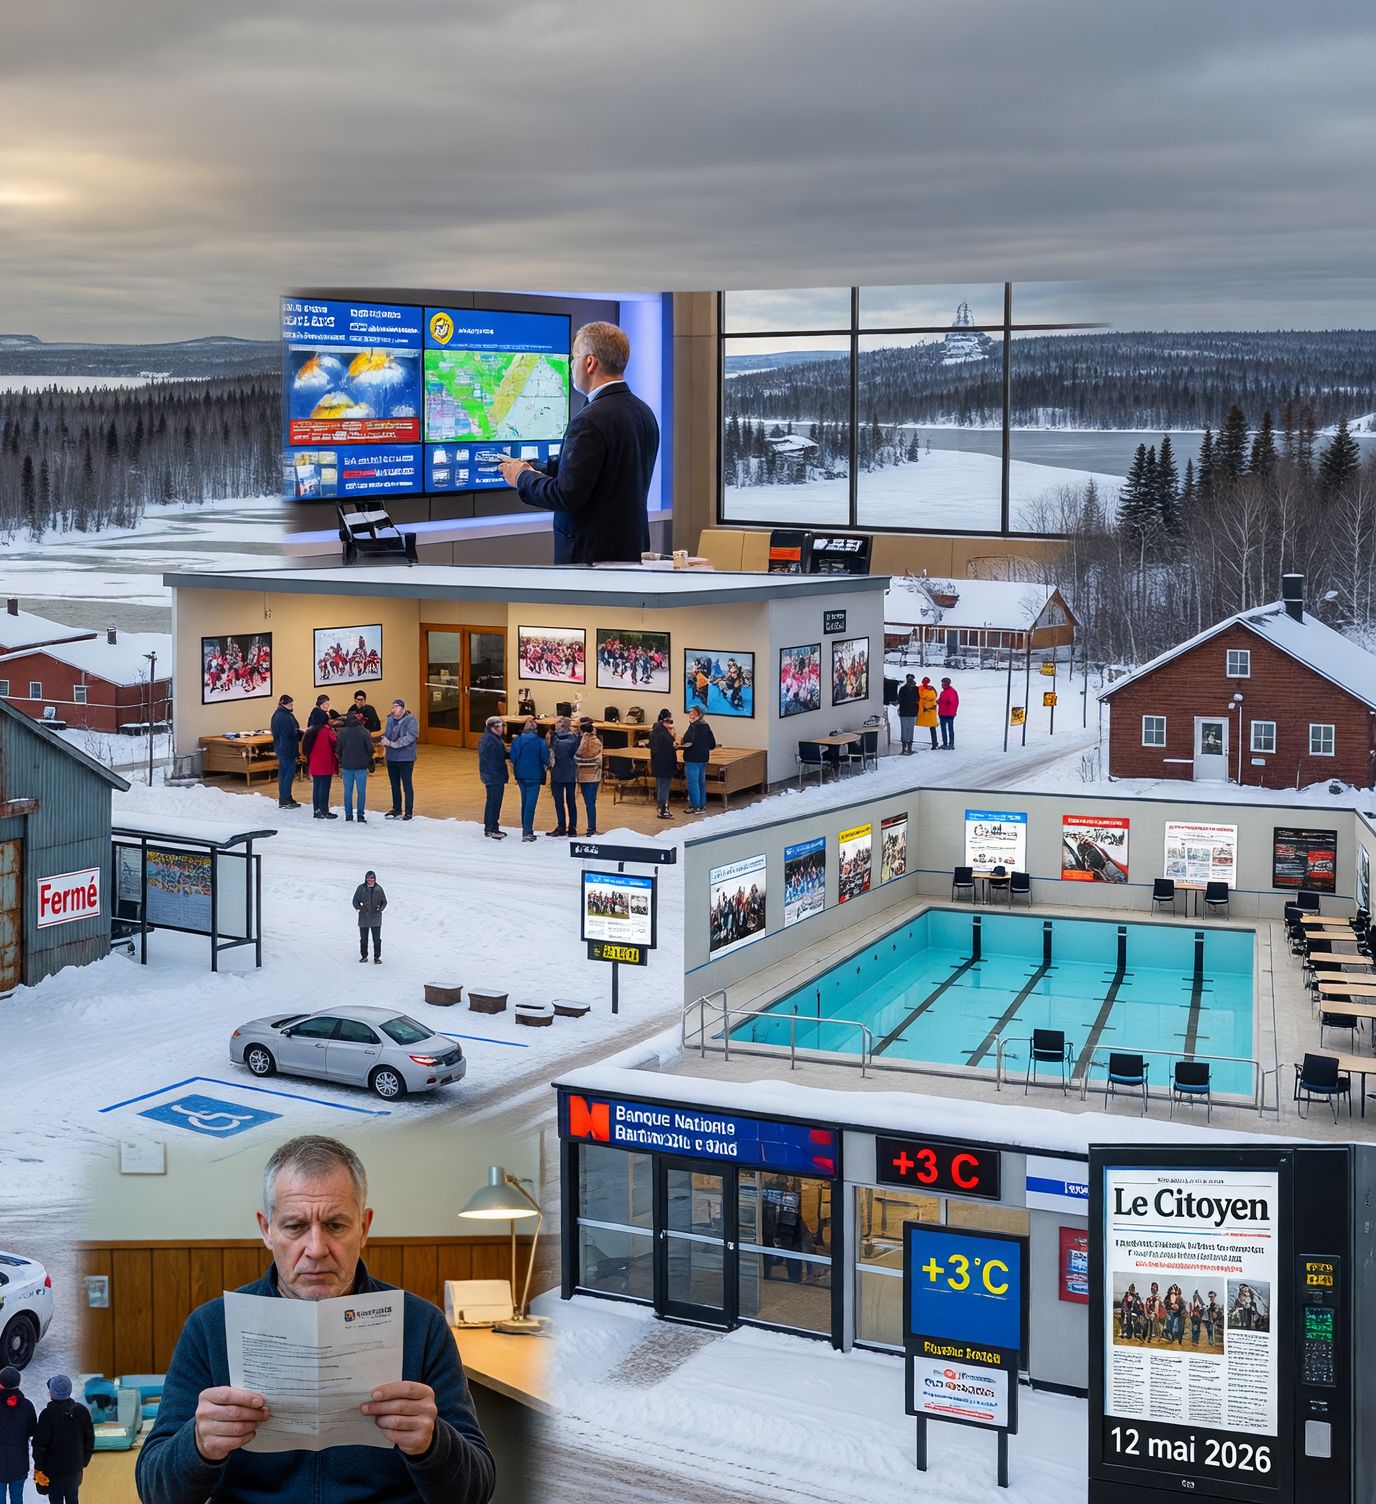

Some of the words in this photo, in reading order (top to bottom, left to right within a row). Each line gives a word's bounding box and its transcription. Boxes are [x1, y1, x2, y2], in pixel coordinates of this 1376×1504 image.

[39, 876, 98, 918] Fermé
[615, 1105, 670, 1127] Banque
[951, 1153, 980, 1189] C
[1114, 1187, 1148, 1217] Le
[1154, 1188, 1271, 1227] Citoyen
[1111, 1426, 1140, 1456] 12
[1148, 1435, 1196, 1464] mai
[1204, 1439, 1272, 1474] 2026
